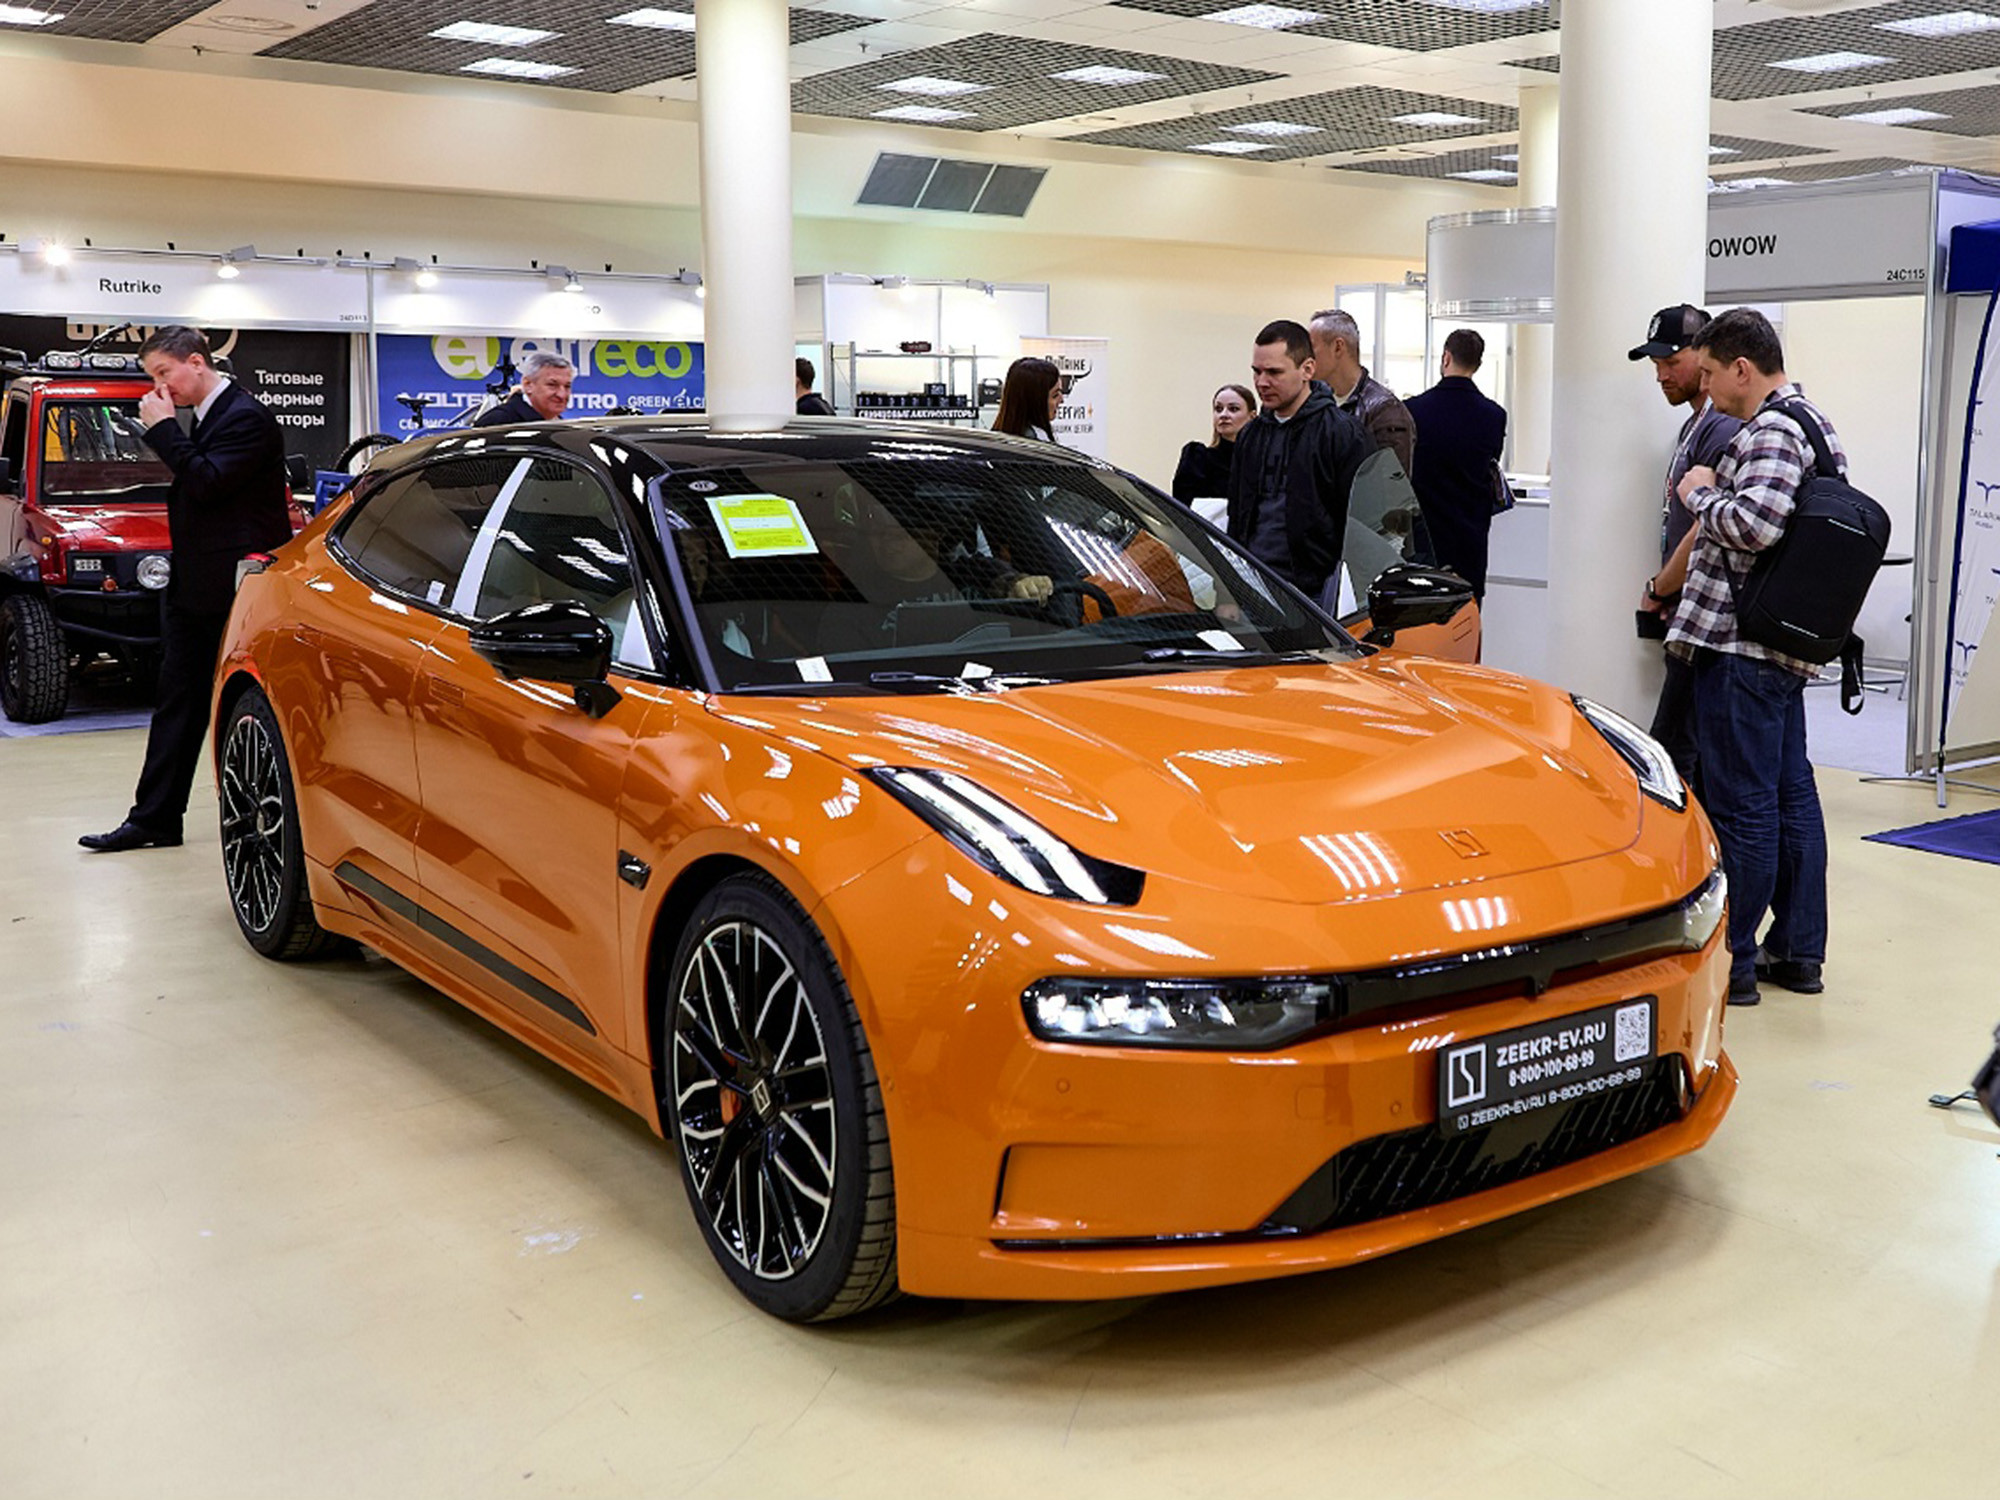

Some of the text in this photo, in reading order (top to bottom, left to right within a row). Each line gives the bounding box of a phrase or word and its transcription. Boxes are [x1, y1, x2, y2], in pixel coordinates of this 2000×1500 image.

[1706, 234, 1777, 258] OWOW
[1886, 268, 1926, 281] 24C115
[99, 278, 162, 295] Rutrike
[254, 369, 325, 385] Тяговые
[254, 390, 325, 408] ферные
[627, 395, 671, 408] GREEN
[1496, 1021, 1607, 1068] ZEEKR-EV.RU
